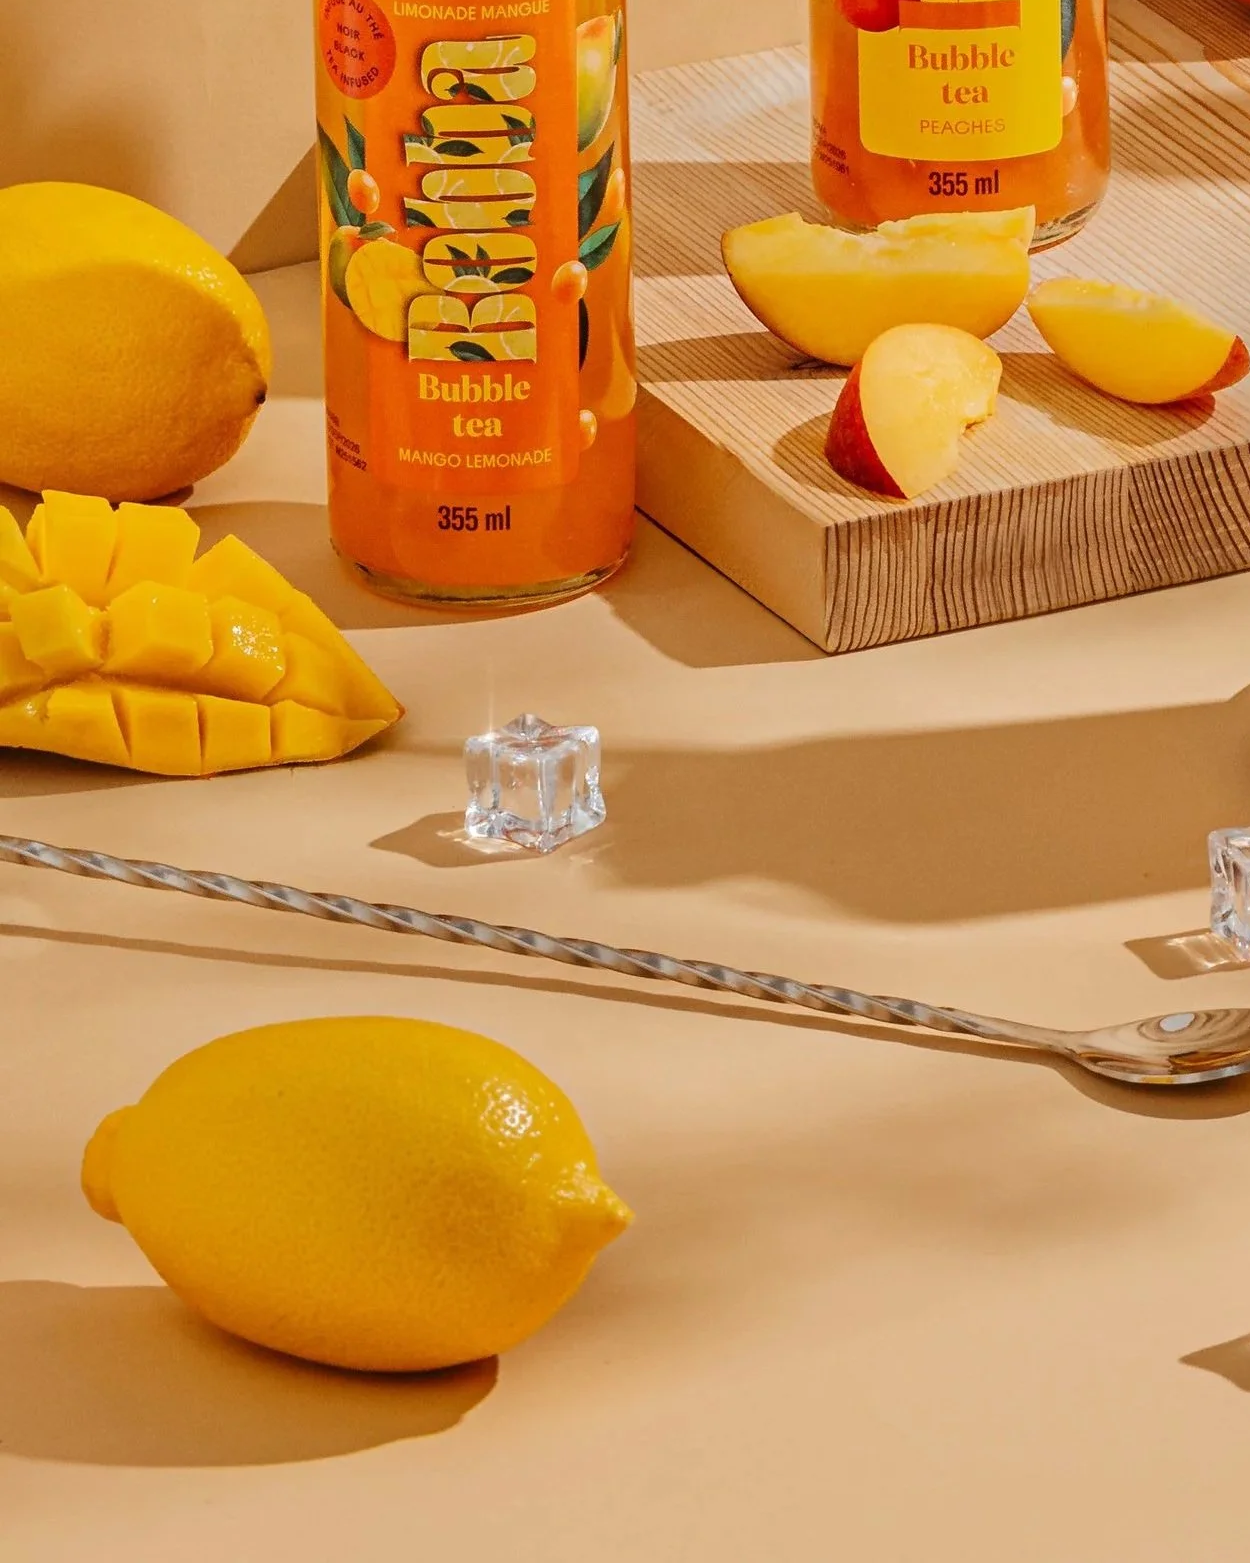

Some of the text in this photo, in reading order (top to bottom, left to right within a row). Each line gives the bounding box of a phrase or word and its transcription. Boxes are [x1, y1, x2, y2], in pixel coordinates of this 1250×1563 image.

[393, 1, 476, 21] LIMONADE
[337, 23, 360, 41] NOIR
[366, 14, 385, 41] THÉ
[333, 40, 365, 61] BLACK
[908, 42, 1015, 71] Bubble
[340, 66, 379, 88] INFUSED
[942, 82, 989, 105] tea
[920, 118, 1006, 136] PEACHES
[928, 169, 1000, 197] 355 ml
[404, 33, 537, 364] Bobba
[418, 373, 531, 403] Bubble
[452, 413, 504, 438] tea
[399, 447, 553, 469] MANGO LEMONADE
[437, 504, 511, 531] 355 ml
